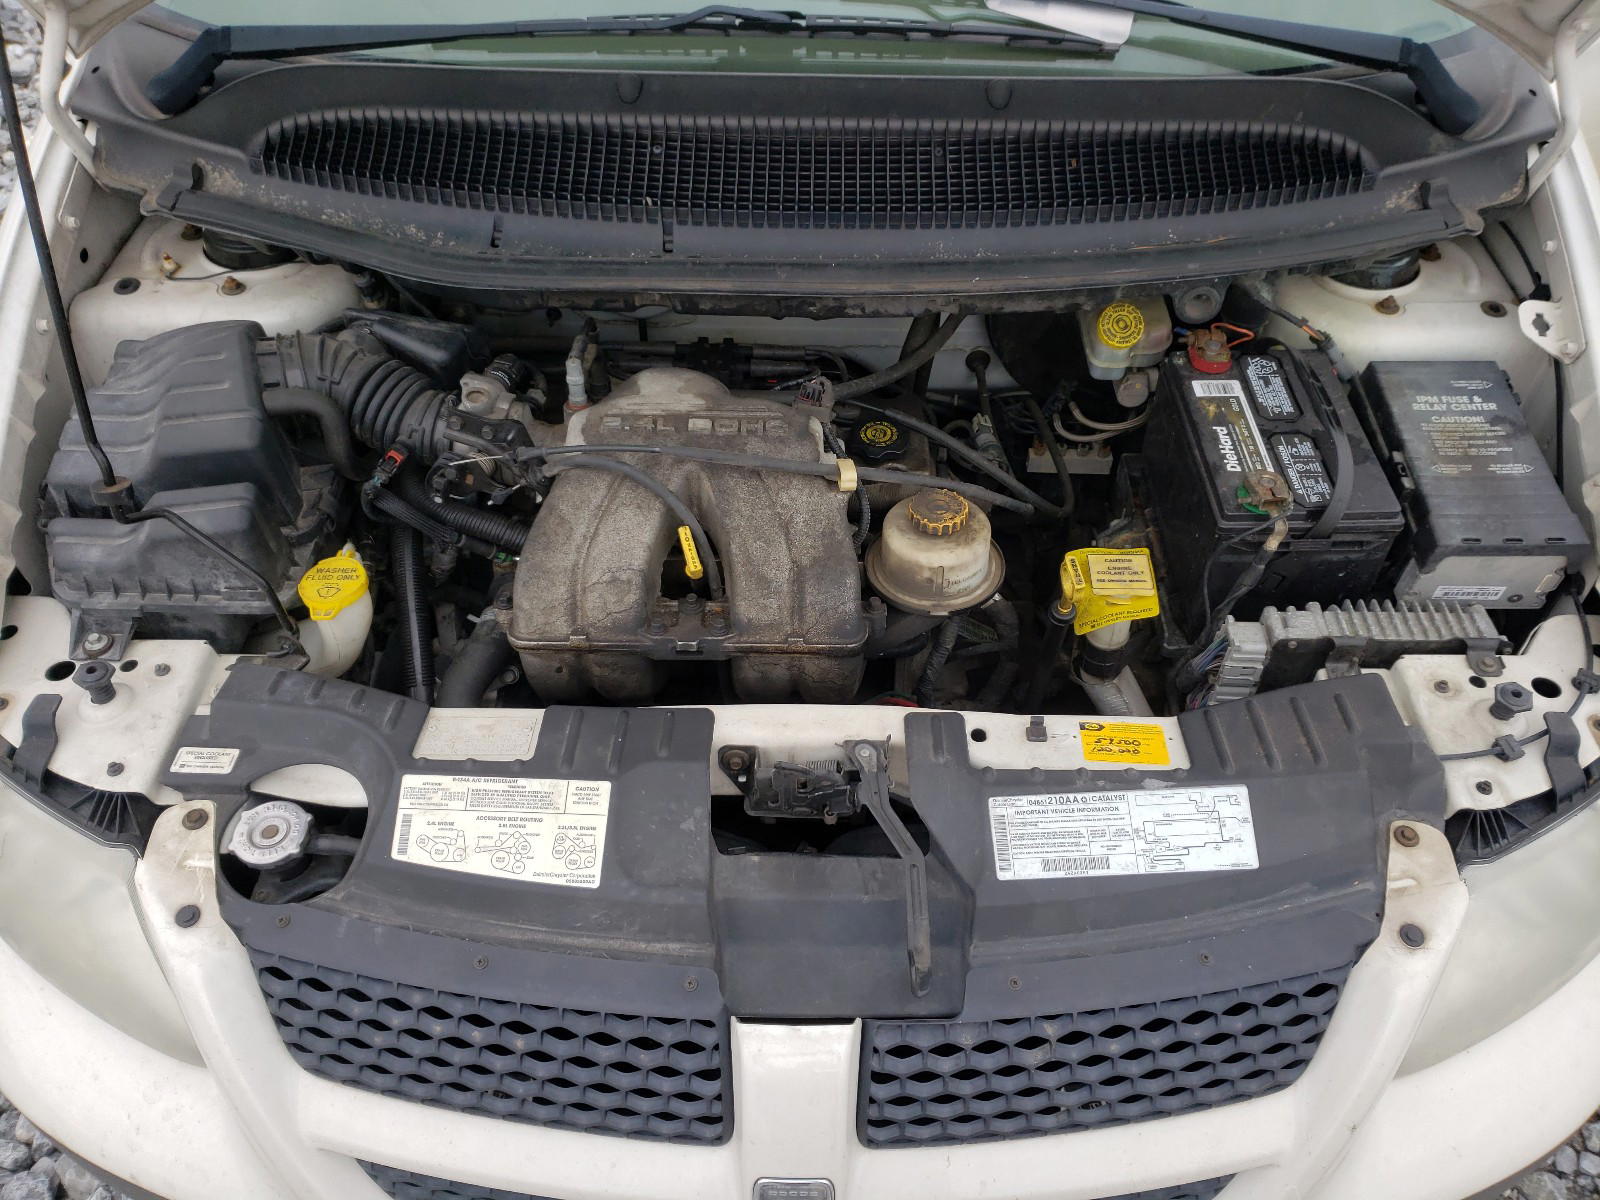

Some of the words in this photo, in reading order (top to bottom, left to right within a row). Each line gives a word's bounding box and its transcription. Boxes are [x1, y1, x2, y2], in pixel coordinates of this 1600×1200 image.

[1442, 395, 1470, 403] FUSE
[1472, 395, 1483, 403] &
[1412, 403, 1447, 411] RELAY
[1455, 403, 1498, 411] CENTER
[1212, 425, 1242, 473] DieHard
[1091, 794, 1126, 802] CATALYST
[1014, 808, 1049, 816] IMPORTANT
[1076, 805, 1120, 813] INFORMATION
